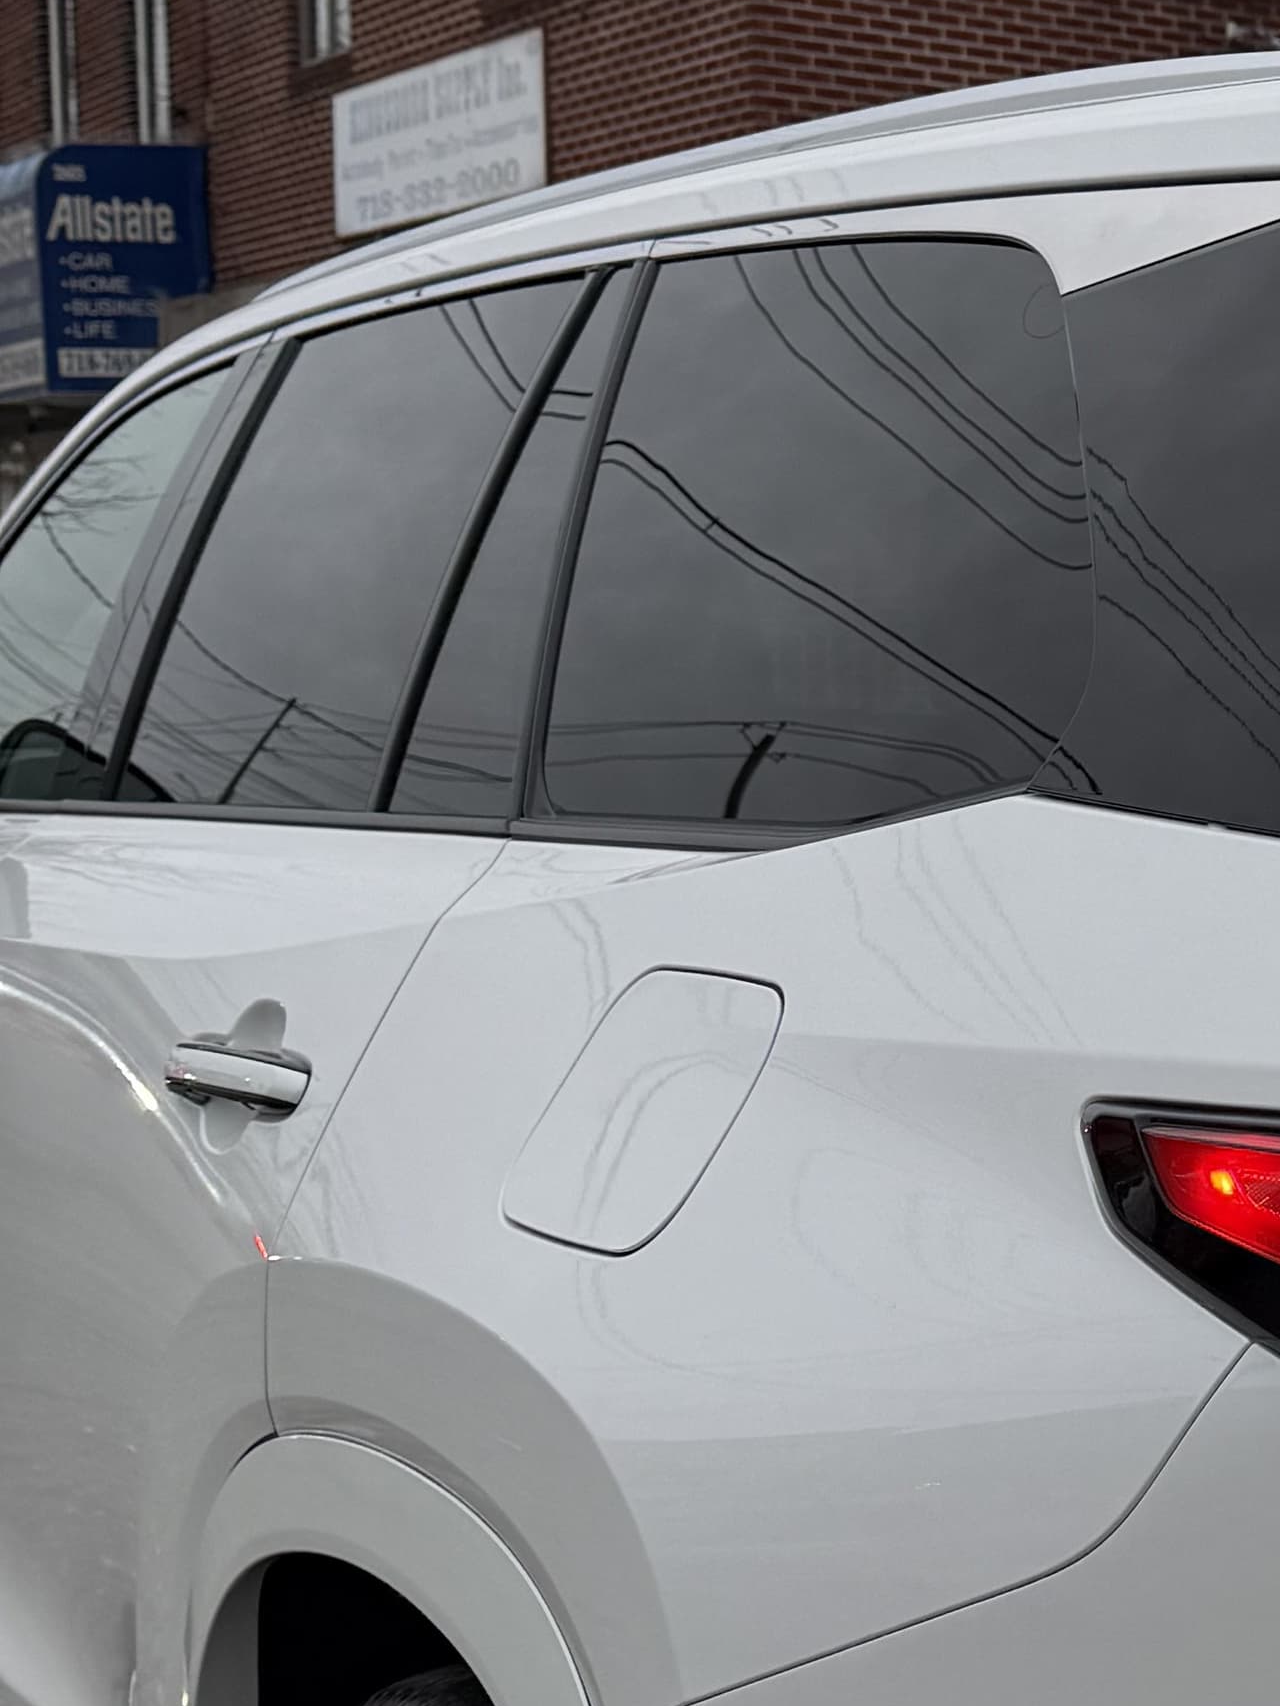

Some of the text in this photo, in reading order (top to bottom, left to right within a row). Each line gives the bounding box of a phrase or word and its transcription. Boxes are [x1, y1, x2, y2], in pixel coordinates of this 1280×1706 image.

[46, 194, 177, 244] Allstate
[69, 275, 130, 294] HOME
[72, 297, 160, 317] BUSINES
[73, 320, 117, 339] LIFE
